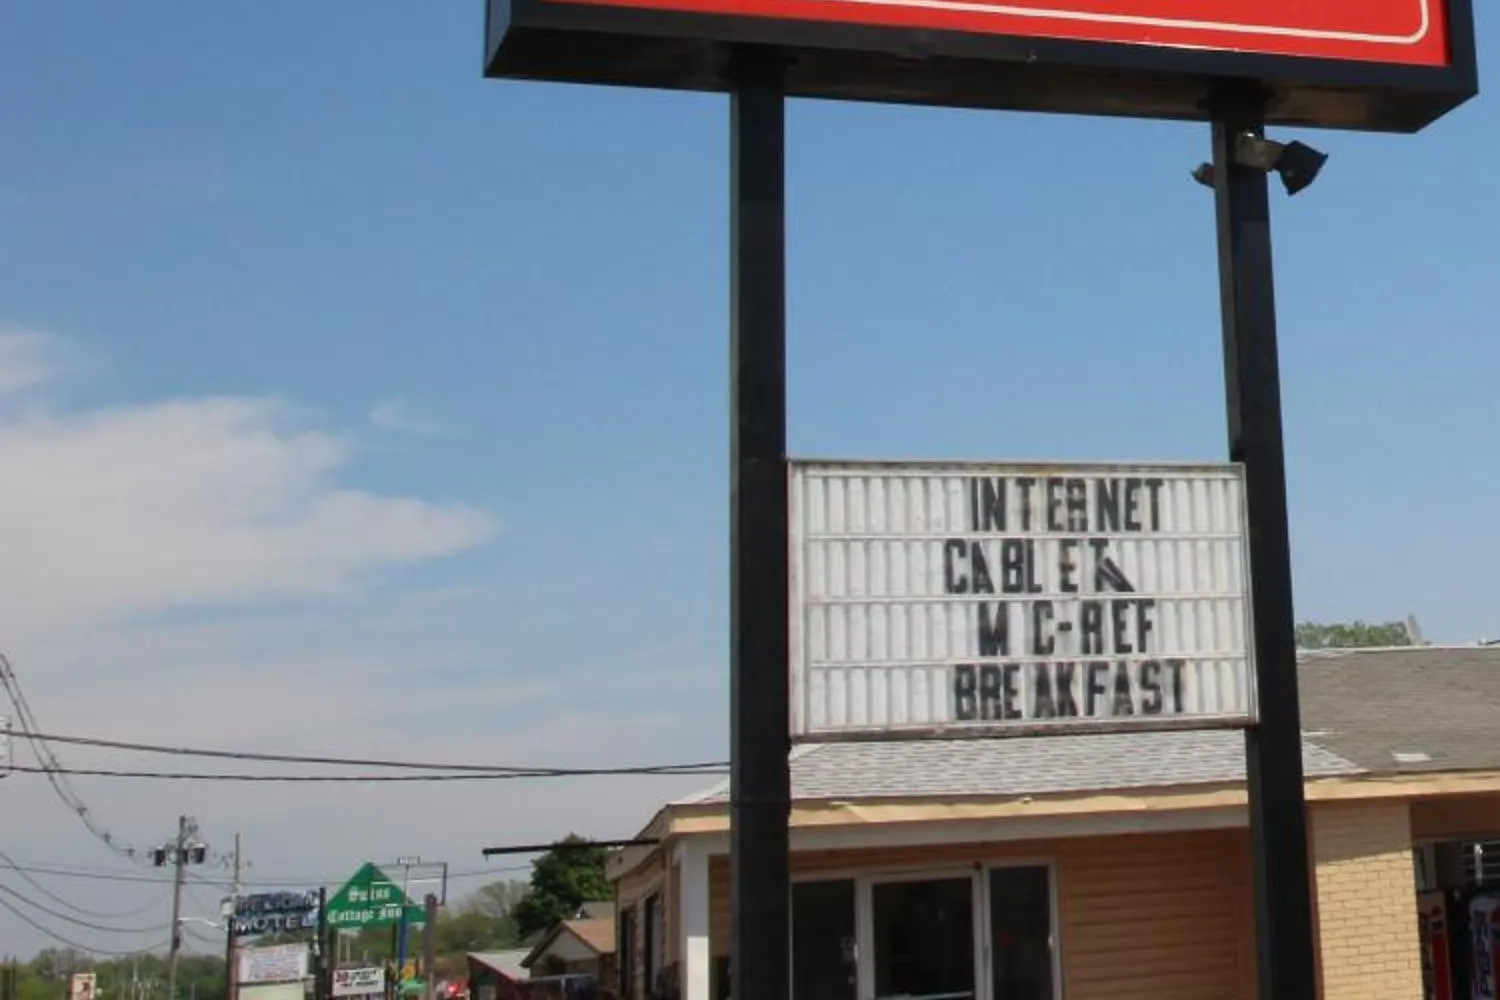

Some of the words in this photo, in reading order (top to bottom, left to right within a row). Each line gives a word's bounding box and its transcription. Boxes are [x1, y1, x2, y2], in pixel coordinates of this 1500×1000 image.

[970, 477, 1164, 532] INTERNET
[944, 538, 1079, 593] CABLE
[954, 658, 1185, 720] BREAKFAST
[235, 911, 315, 932] MOTEL
